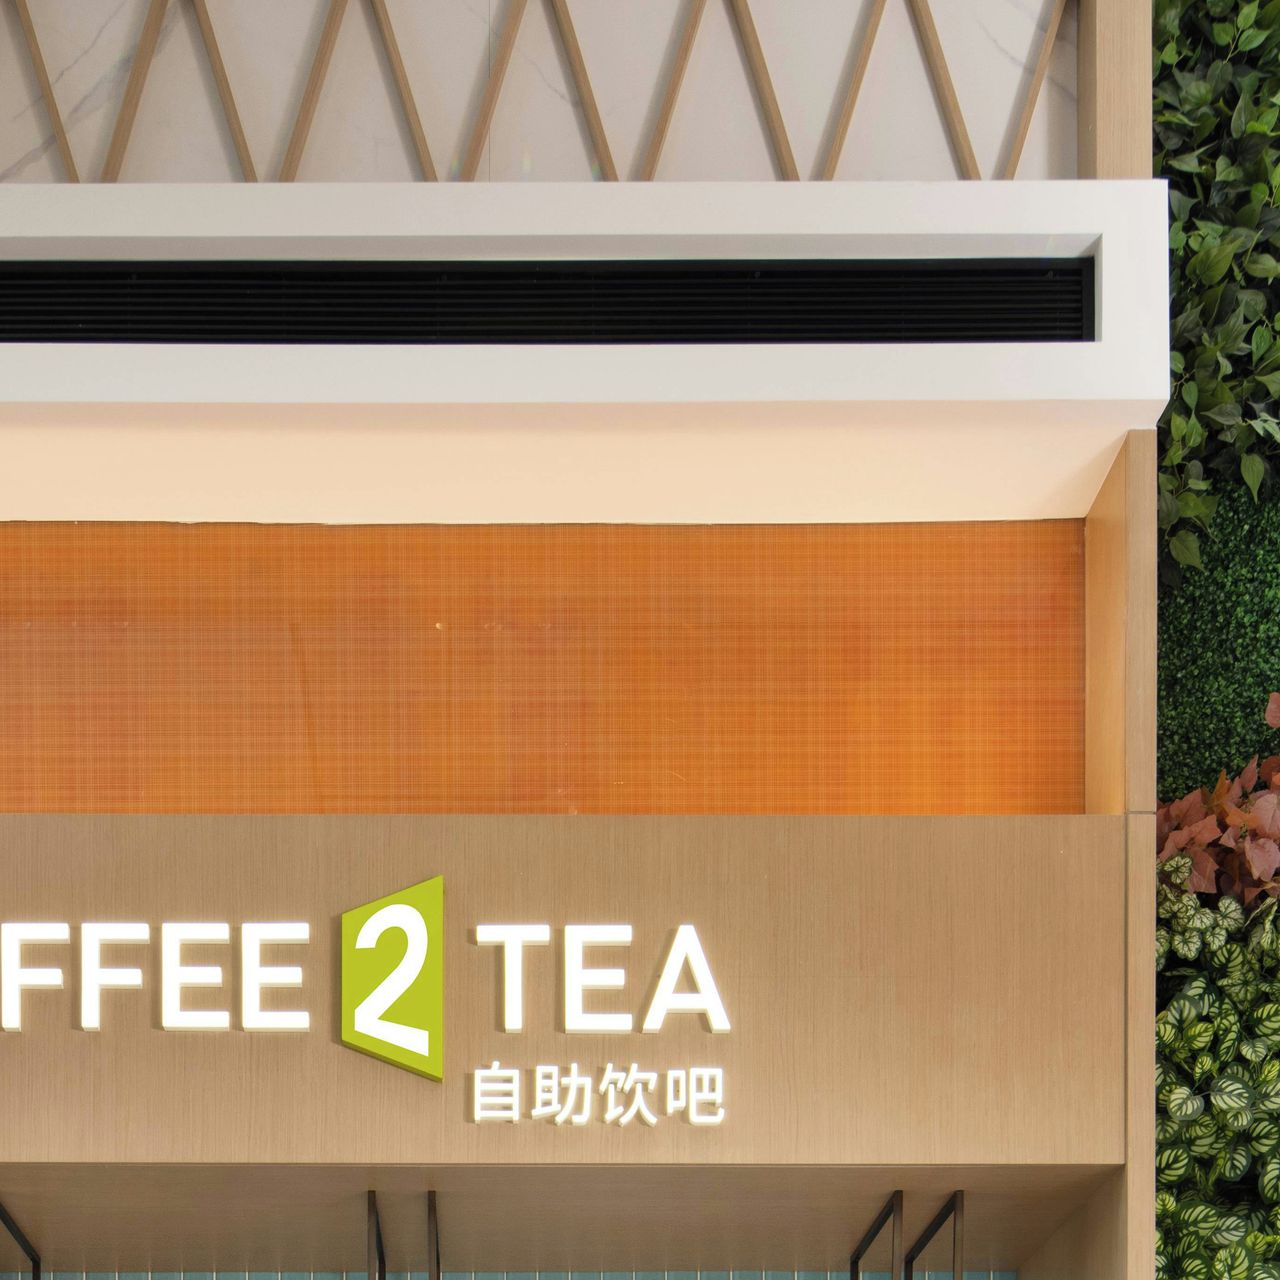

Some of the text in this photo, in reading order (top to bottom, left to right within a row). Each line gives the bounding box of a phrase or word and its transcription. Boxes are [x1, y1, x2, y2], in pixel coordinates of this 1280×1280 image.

[354, 903, 430, 1058] 2
[475, 923, 732, 1034] TEA
[473, 1060, 726, 1127] 自助饮吧
